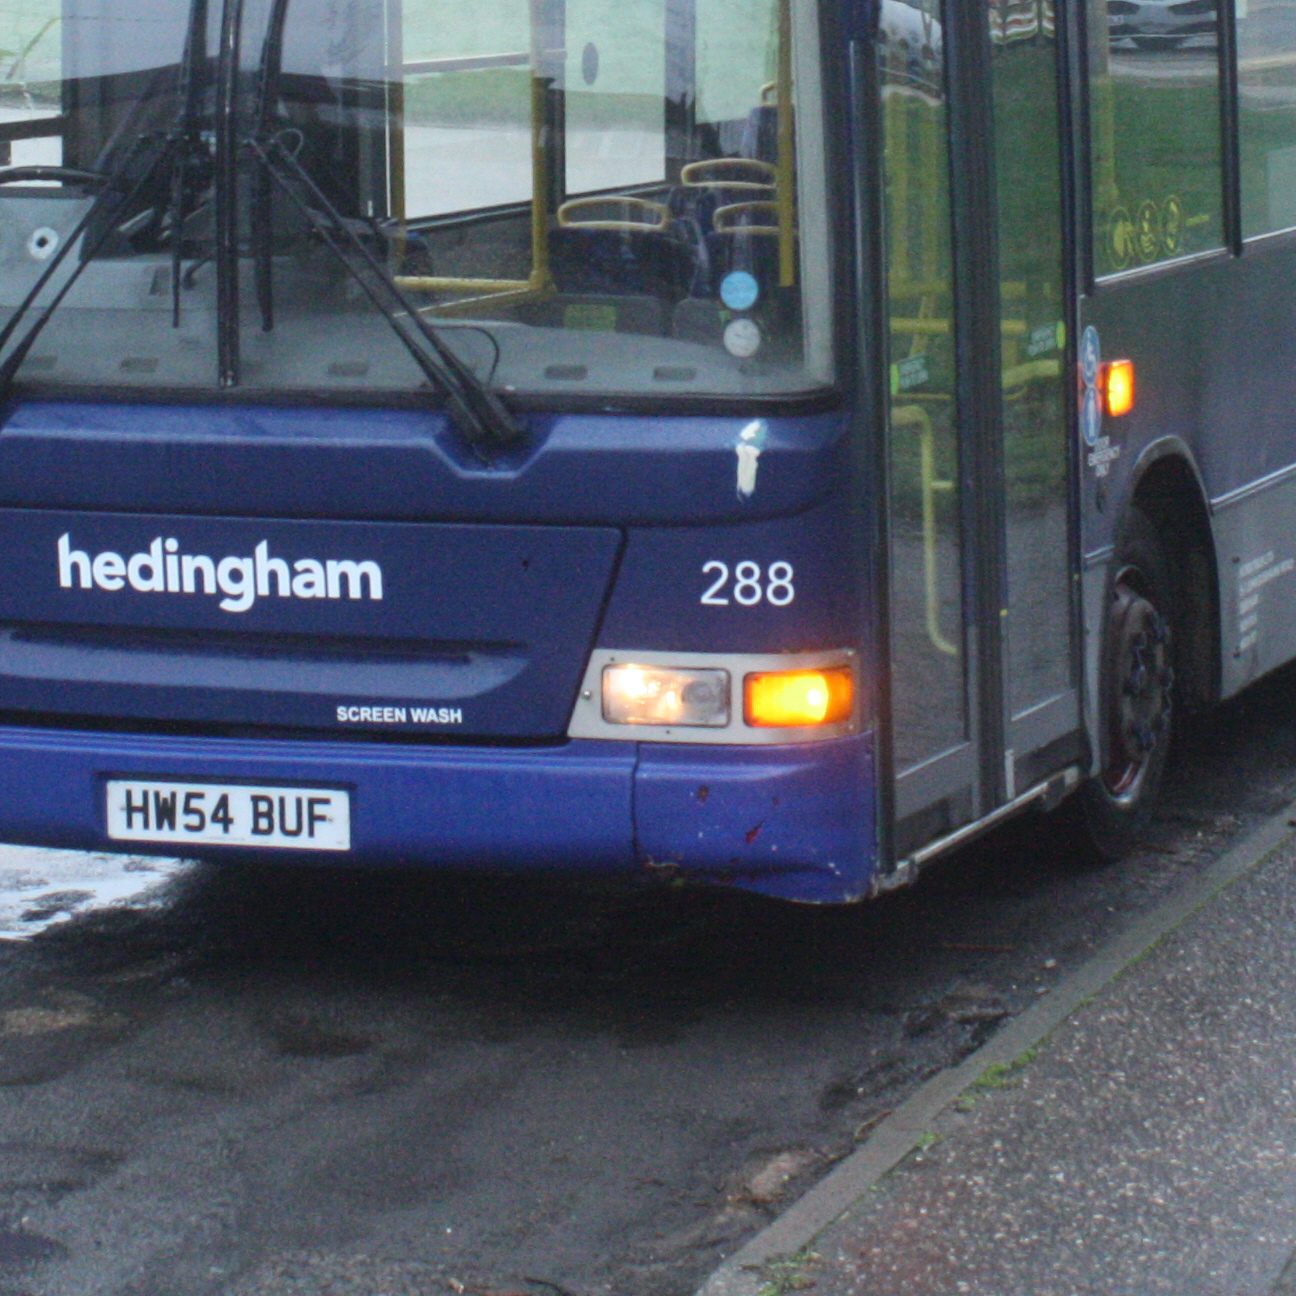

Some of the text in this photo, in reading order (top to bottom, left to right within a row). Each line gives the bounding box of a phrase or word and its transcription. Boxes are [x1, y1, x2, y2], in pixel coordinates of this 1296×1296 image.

[57, 532, 383, 613] hedingham
[700, 560, 795, 606] 288
[336, 706, 463, 724] SCREEN WASH
[125, 789, 332, 838] HW54 BUF
